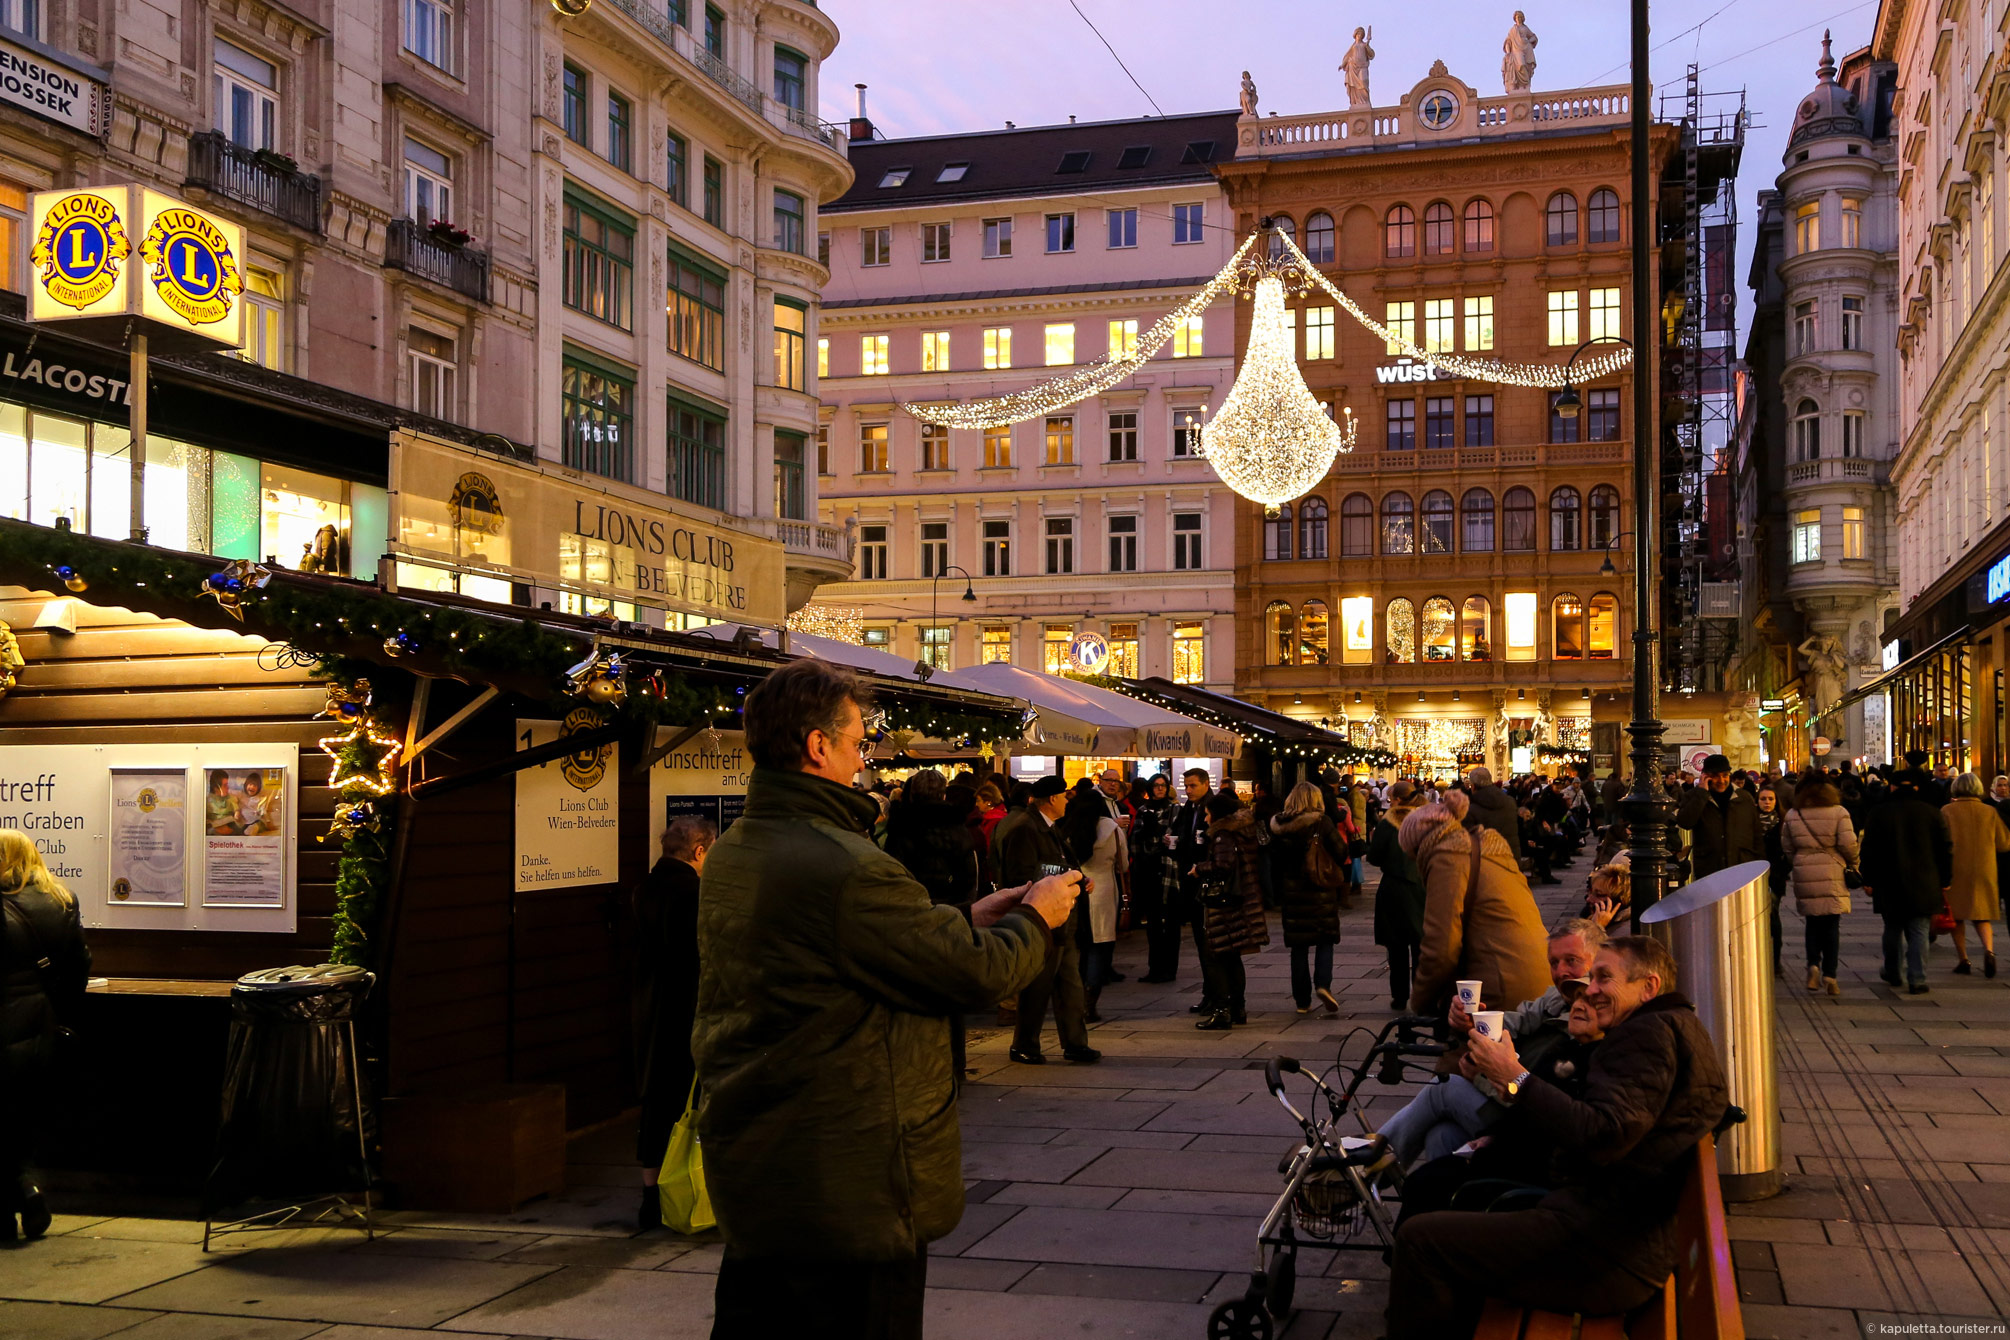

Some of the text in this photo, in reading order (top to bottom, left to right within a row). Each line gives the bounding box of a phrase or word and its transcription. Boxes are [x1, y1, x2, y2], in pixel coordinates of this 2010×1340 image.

[0, 50, 78, 98] ENSION
[104, 88, 112, 136] NOSSEK
[52, 197, 109, 223] LIONS
[164, 213, 225, 248] LIONS
[69, 228, 95, 269] L
[181, 242, 209, 288] L
[52, 279, 109, 301] INTERNATIONAL
[164, 286, 223, 317] INTERNATIONAL
[463, 475, 493, 496] LIONS
[574, 499, 735, 573] LIONS CLUB
[579, 550, 746, 611] N-BELVEDERE
[1080, 641, 1101, 666] K
[569, 708, 600, 727] LIONS
[1153, 731, 1182, 751] Kiwanis
[1208, 736, 1230, 754] Kiwanis
[652, 747, 743, 770] unschtreff
[0, 774, 55, 802] treff
[568, 771, 601, 785] INTERNATIONAL
[722, 772, 751, 786] am Gr
[117, 798, 137, 808] Lions
[560, 797, 609, 812] Lions Club
[23, 811, 84, 830] Graben
[547, 815, 616, 830] Wien-Belvedere
[35, 838, 66, 855] Club
[209, 841, 244, 850] Spielothek
[48, 862, 83, 878] edere
[521, 854, 551, 868] Danke.
[520, 865, 602, 884] Sie helfen uns helfen.
